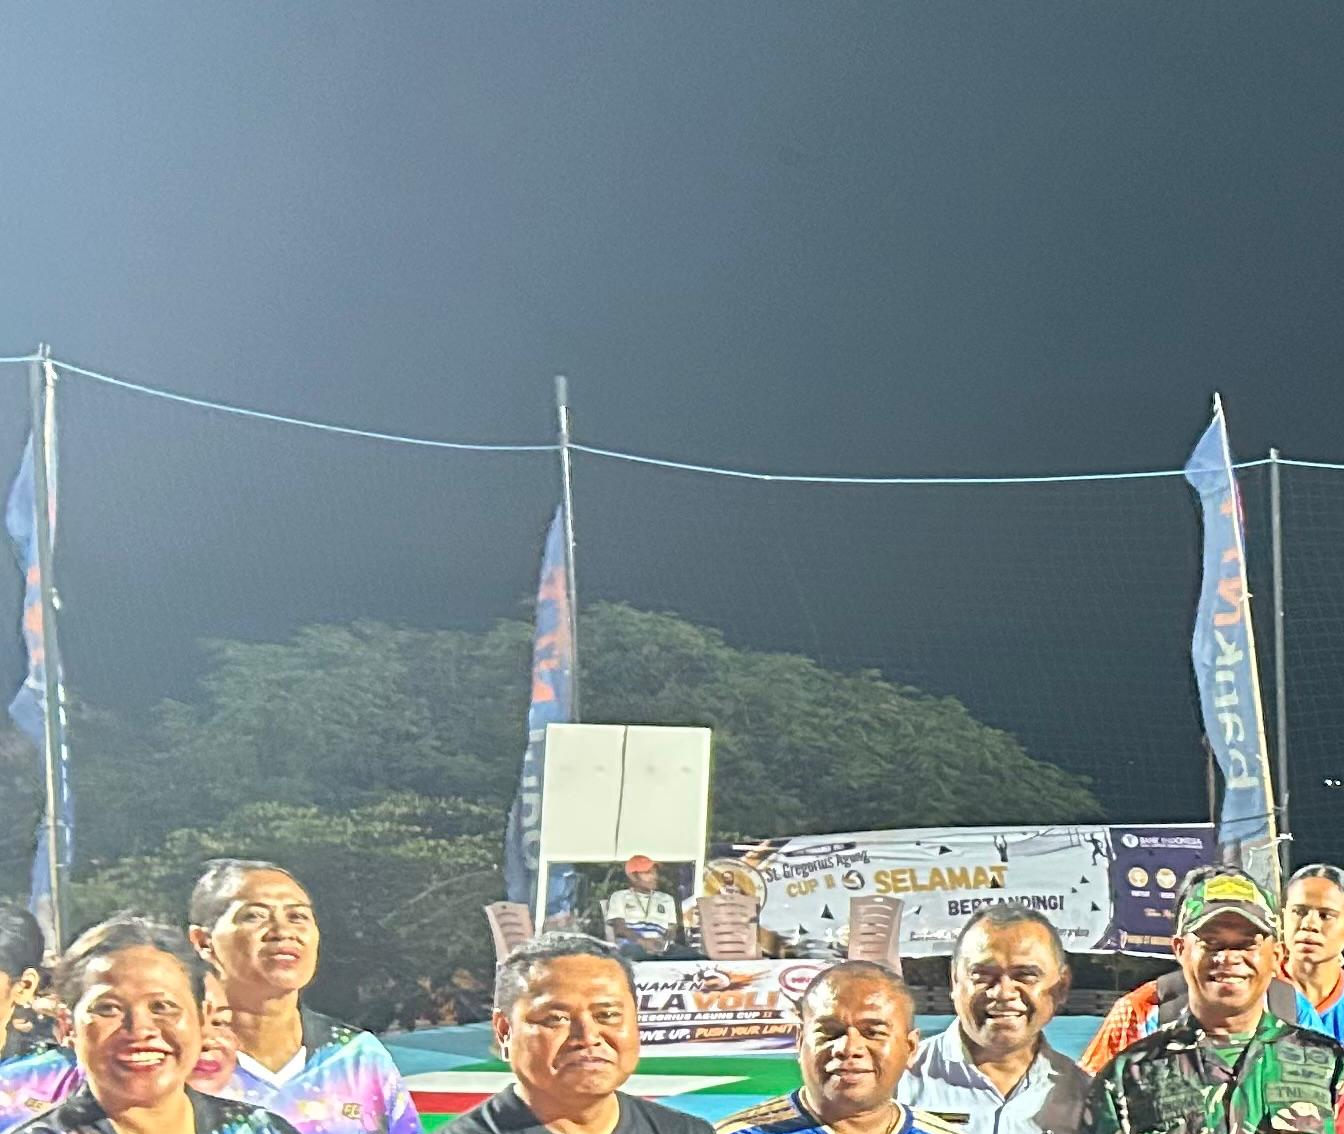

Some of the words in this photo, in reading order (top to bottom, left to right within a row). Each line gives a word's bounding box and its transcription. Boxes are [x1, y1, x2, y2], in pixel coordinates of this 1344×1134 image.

[782, 856, 834, 879] Gregorius
[836, 850, 871, 869] Agung
[785, 877, 820, 898] CUP
[874, 865, 1008, 894] SELAMAT
[639, 993, 687, 1012] LA
[692, 990, 780, 1012] VOLI
[736, 1011, 760, 1020] CUP
[695, 1025, 728, 1038] PUSH
